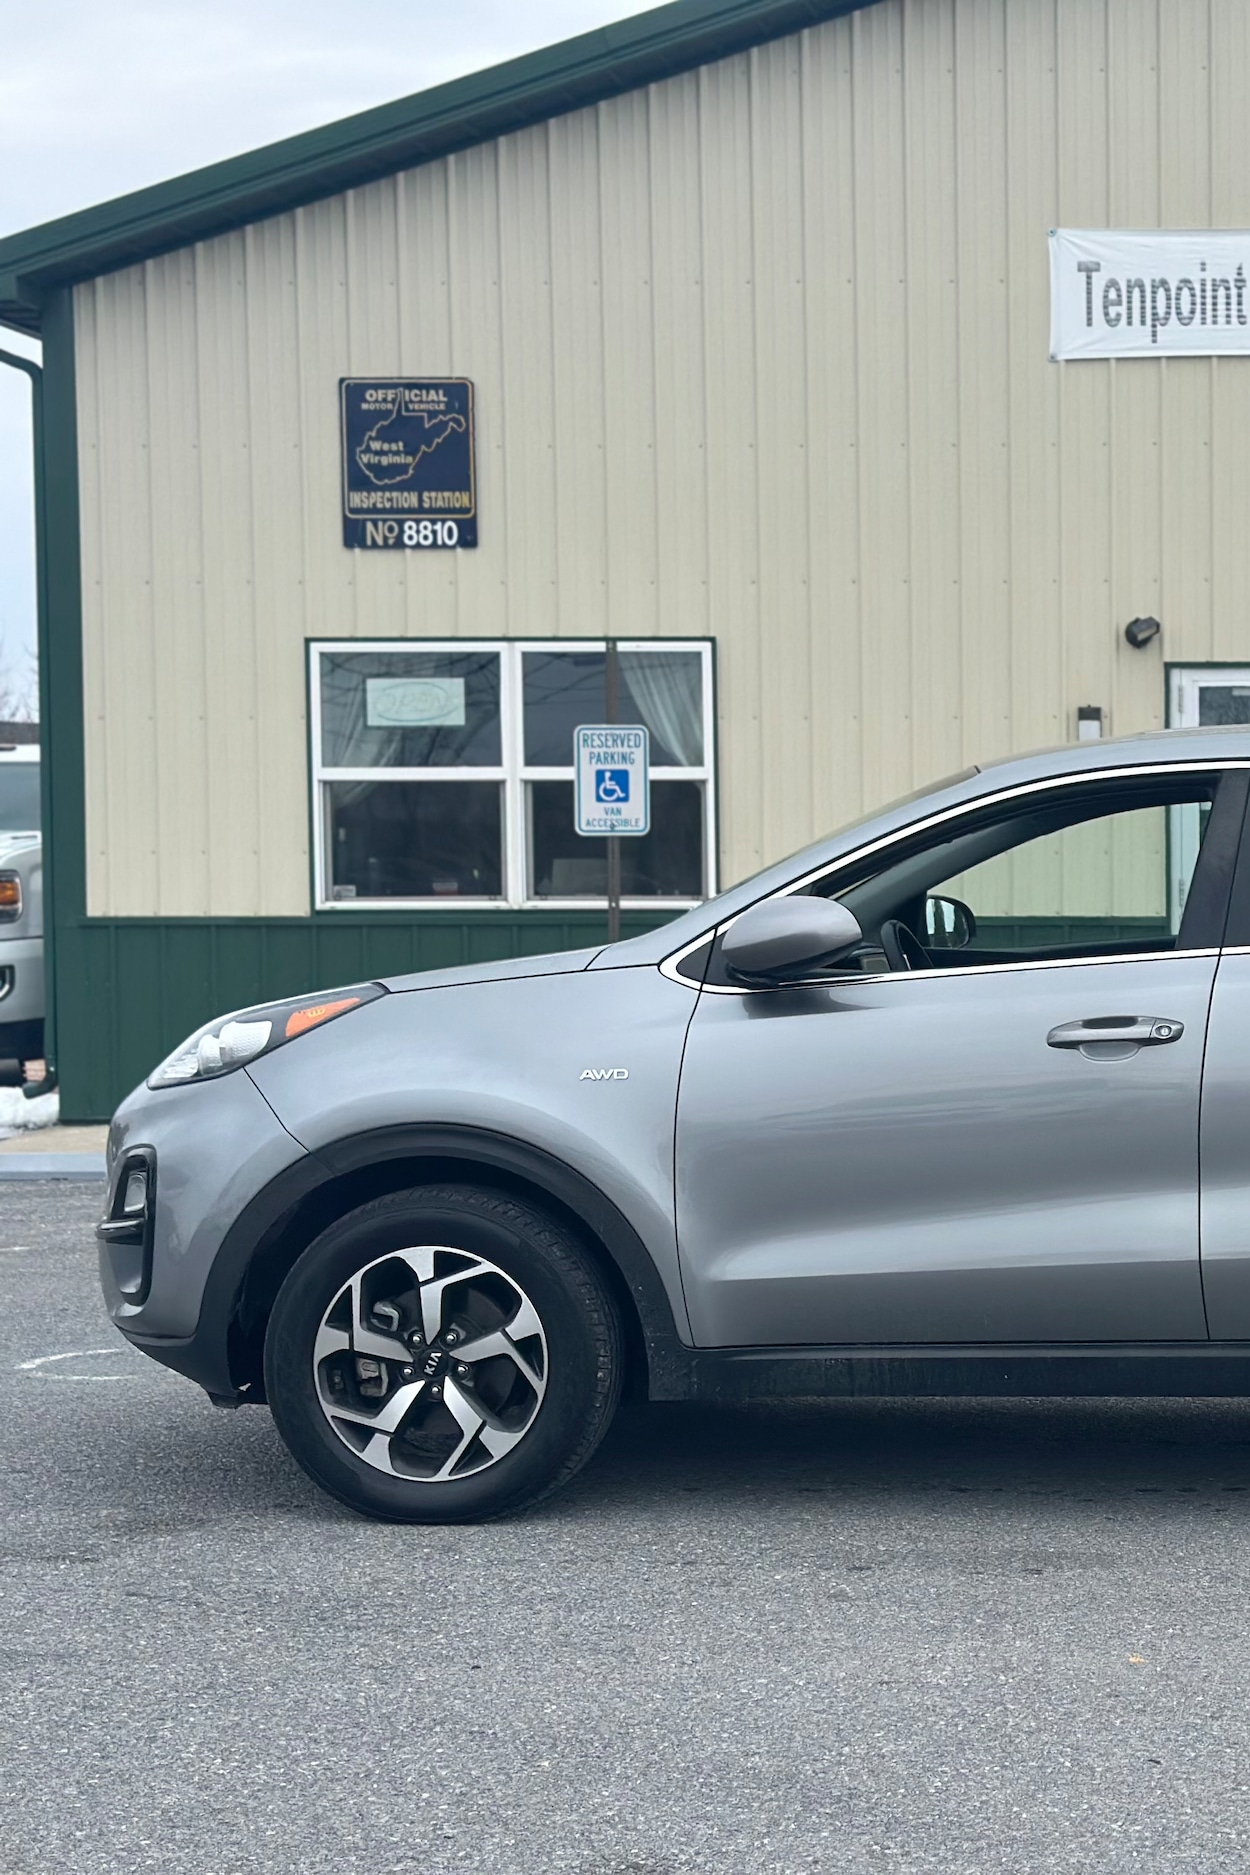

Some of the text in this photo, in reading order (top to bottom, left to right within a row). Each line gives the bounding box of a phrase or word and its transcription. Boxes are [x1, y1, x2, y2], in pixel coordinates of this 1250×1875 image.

[1077, 259, 1248, 344] Tenpoint
[361, 402, 446, 411] MOTOR VEHICLE
[369, 440, 404, 451] West
[360, 453, 413, 466] Virginia
[350, 491, 470, 509] INSPECTION STATION
[403, 520, 459, 546] 8810
[582, 732, 642, 749] RESERVED
[589, 751, 635, 766] PARKING
[603, 806, 622, 817] VAN
[585, 818, 640, 828] ACCESSIBLE
[579, 1068, 629, 1081] AWD
[424, 1353, 441, 1375] KIA
